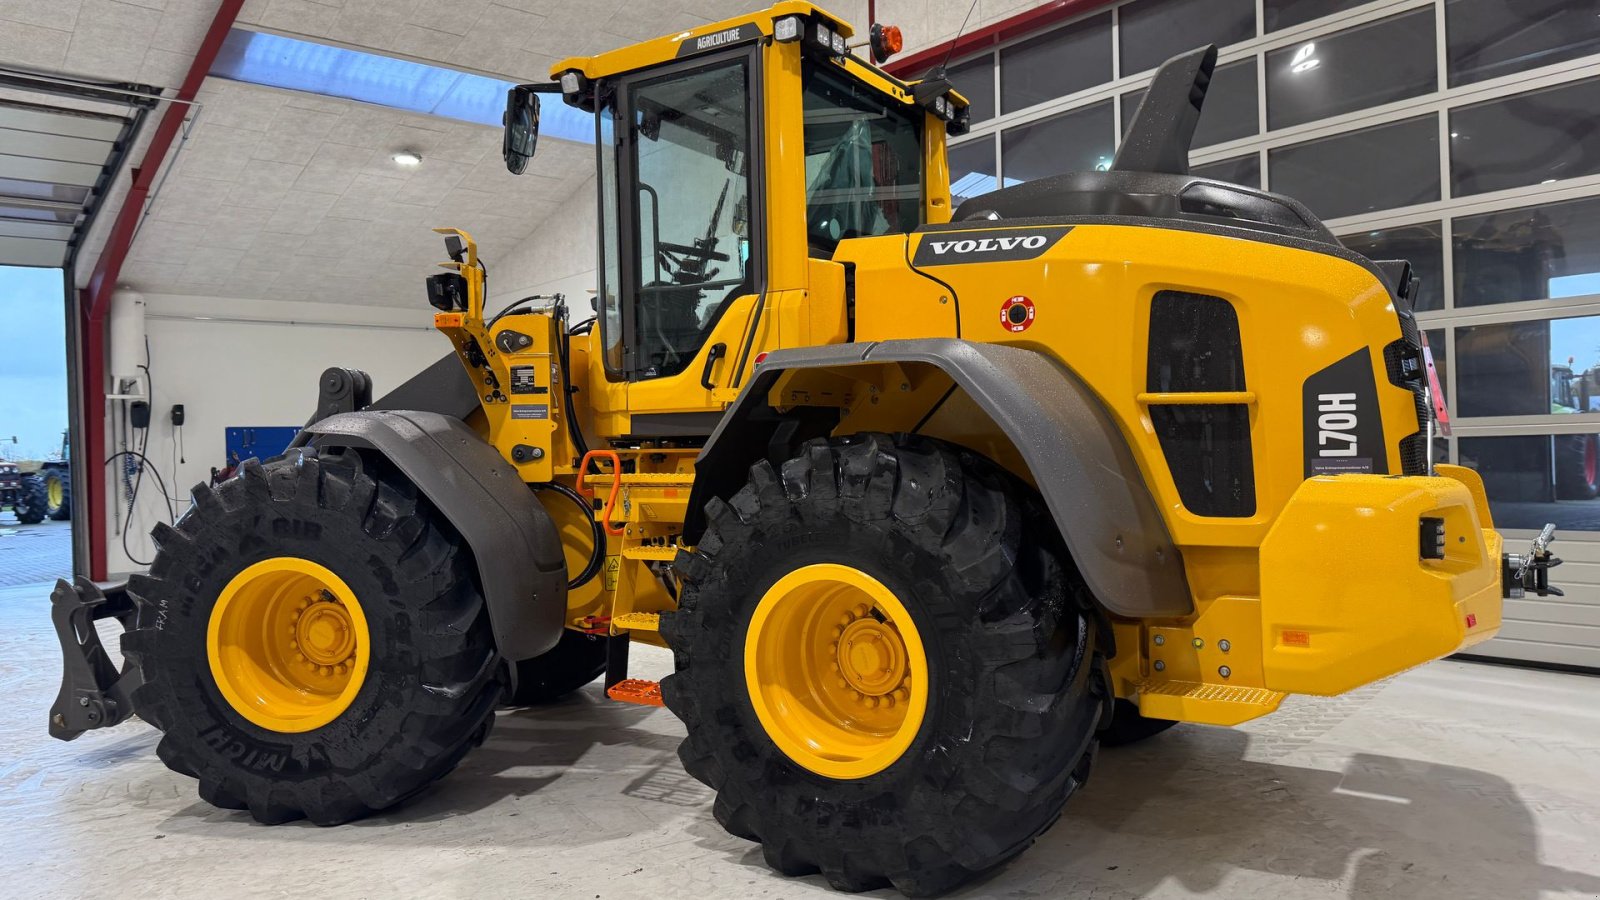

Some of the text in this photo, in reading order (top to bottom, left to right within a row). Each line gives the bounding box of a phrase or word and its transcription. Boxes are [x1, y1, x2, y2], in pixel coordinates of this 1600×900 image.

[697, 28, 740, 50] AGRICULTURE
[929, 235, 1047, 255] VOLVO
[1318, 392, 1358, 457] L70H
